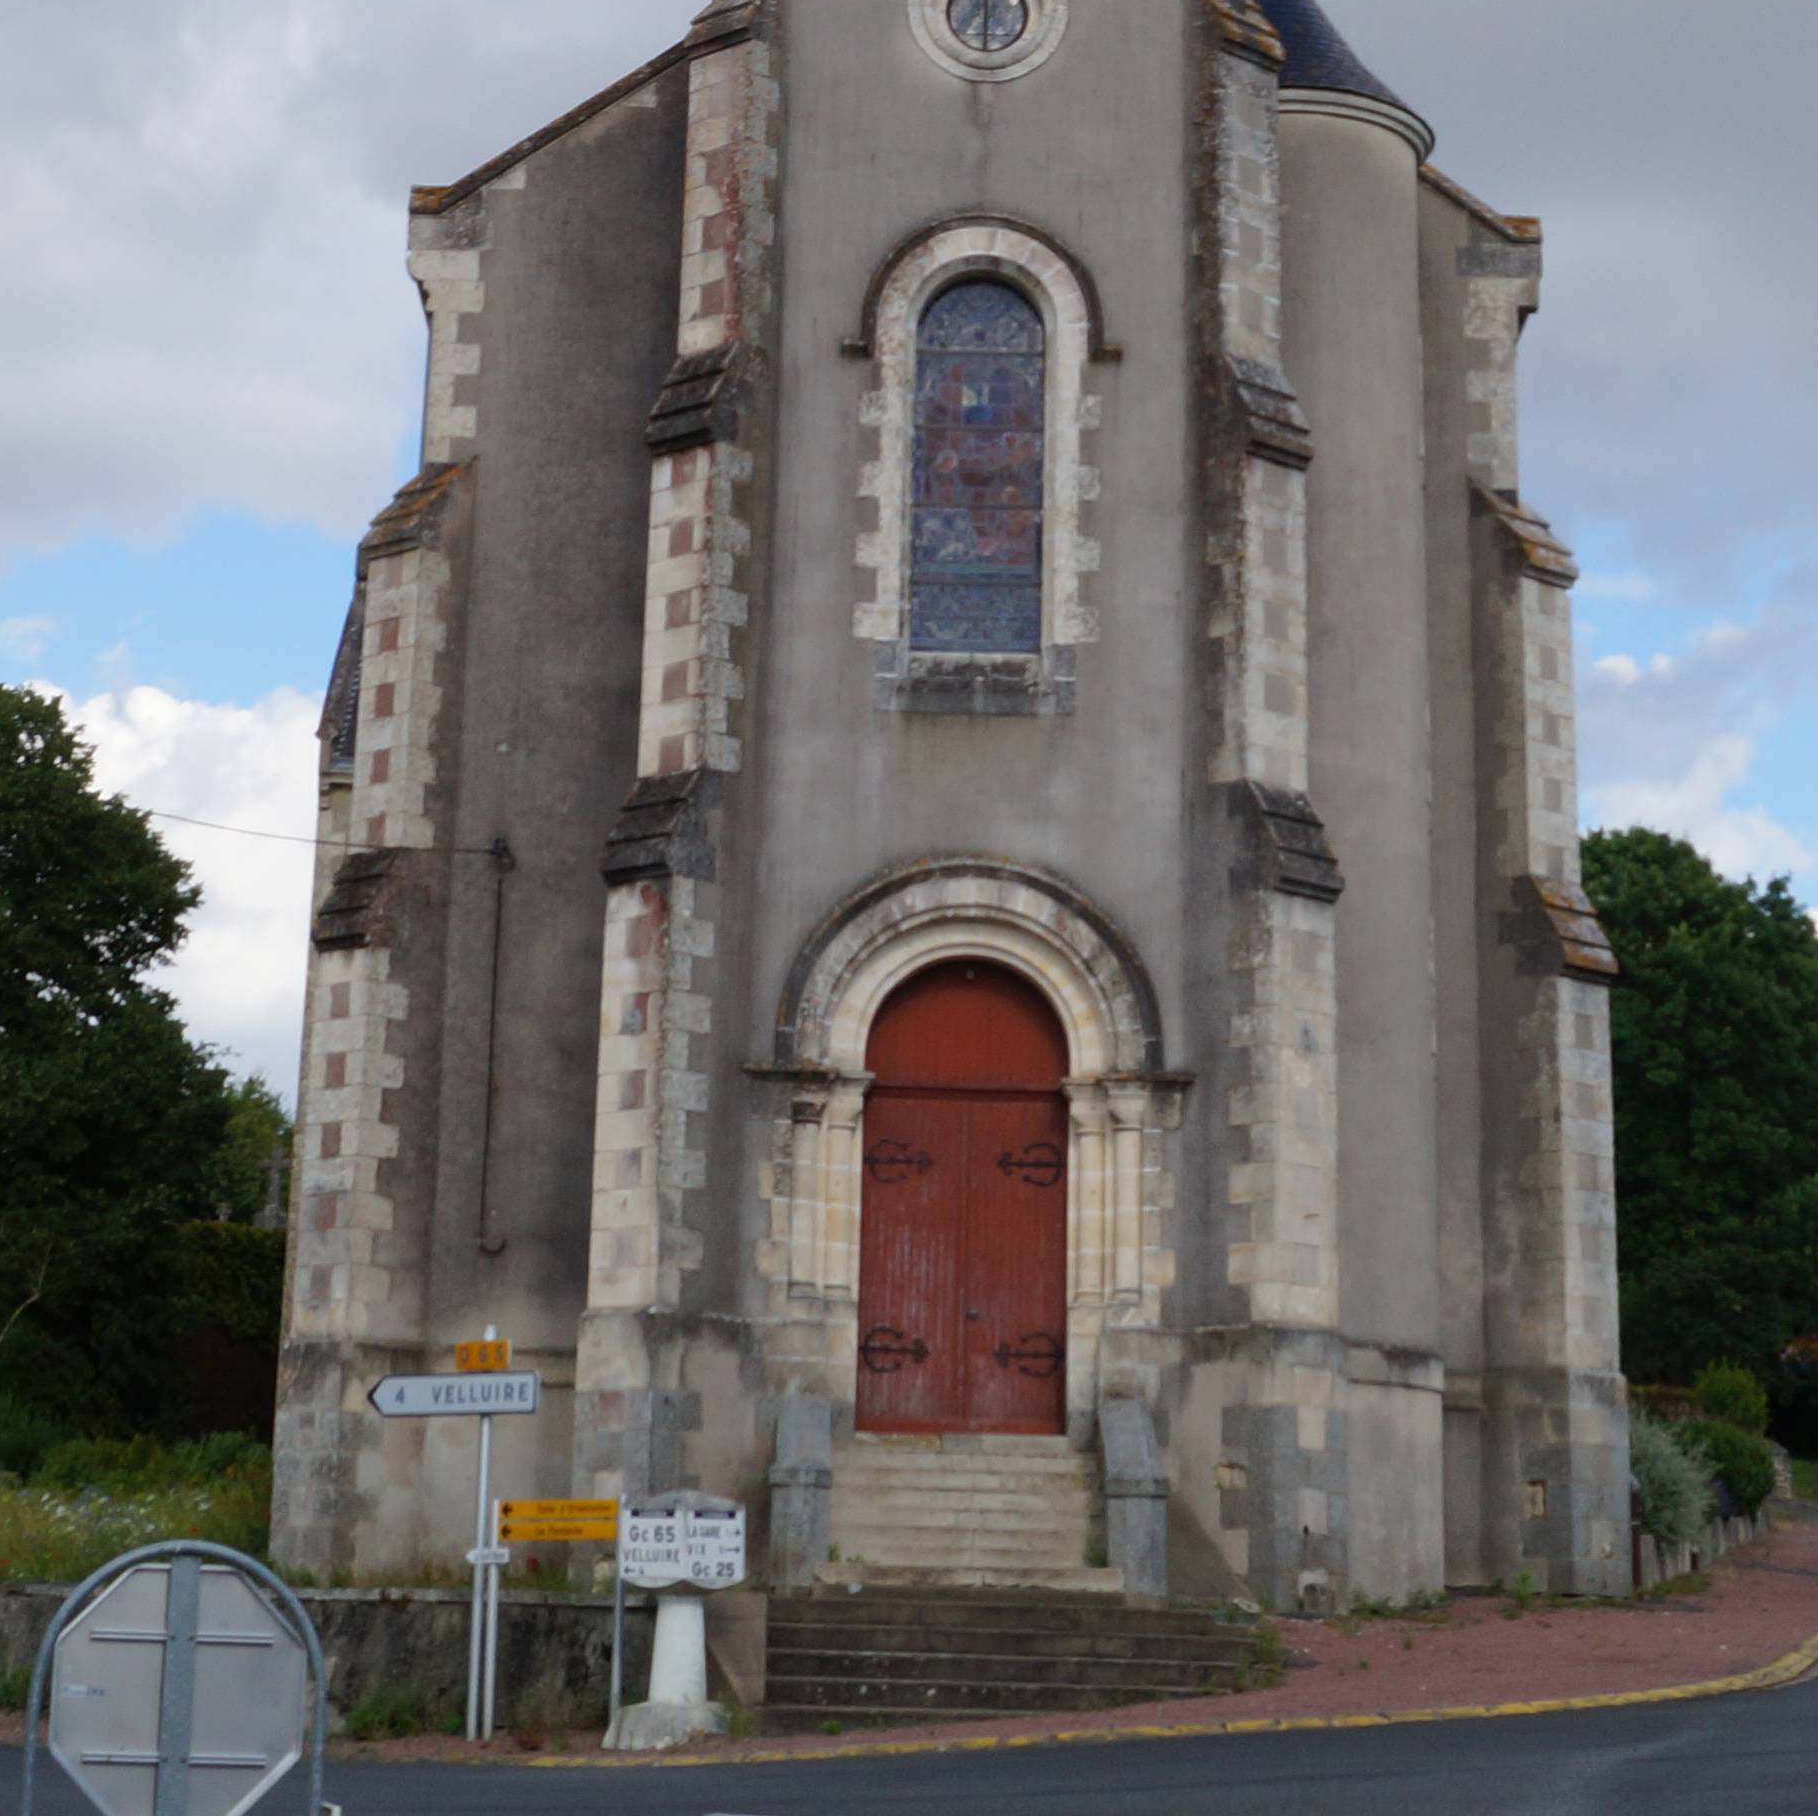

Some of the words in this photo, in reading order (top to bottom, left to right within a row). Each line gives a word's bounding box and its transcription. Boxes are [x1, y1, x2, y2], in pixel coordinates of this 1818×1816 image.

[394, 1386, 406, 1404] 4
[431, 1382, 530, 1404] VELLUIRE
[629, 1525, 649, 1543] Gc
[654, 1525, 676, 1543] 65
[623, 1548, 681, 1563] VELLUIRE
[692, 1561, 710, 1577] Gc
[716, 1562, 735, 1577] 25
